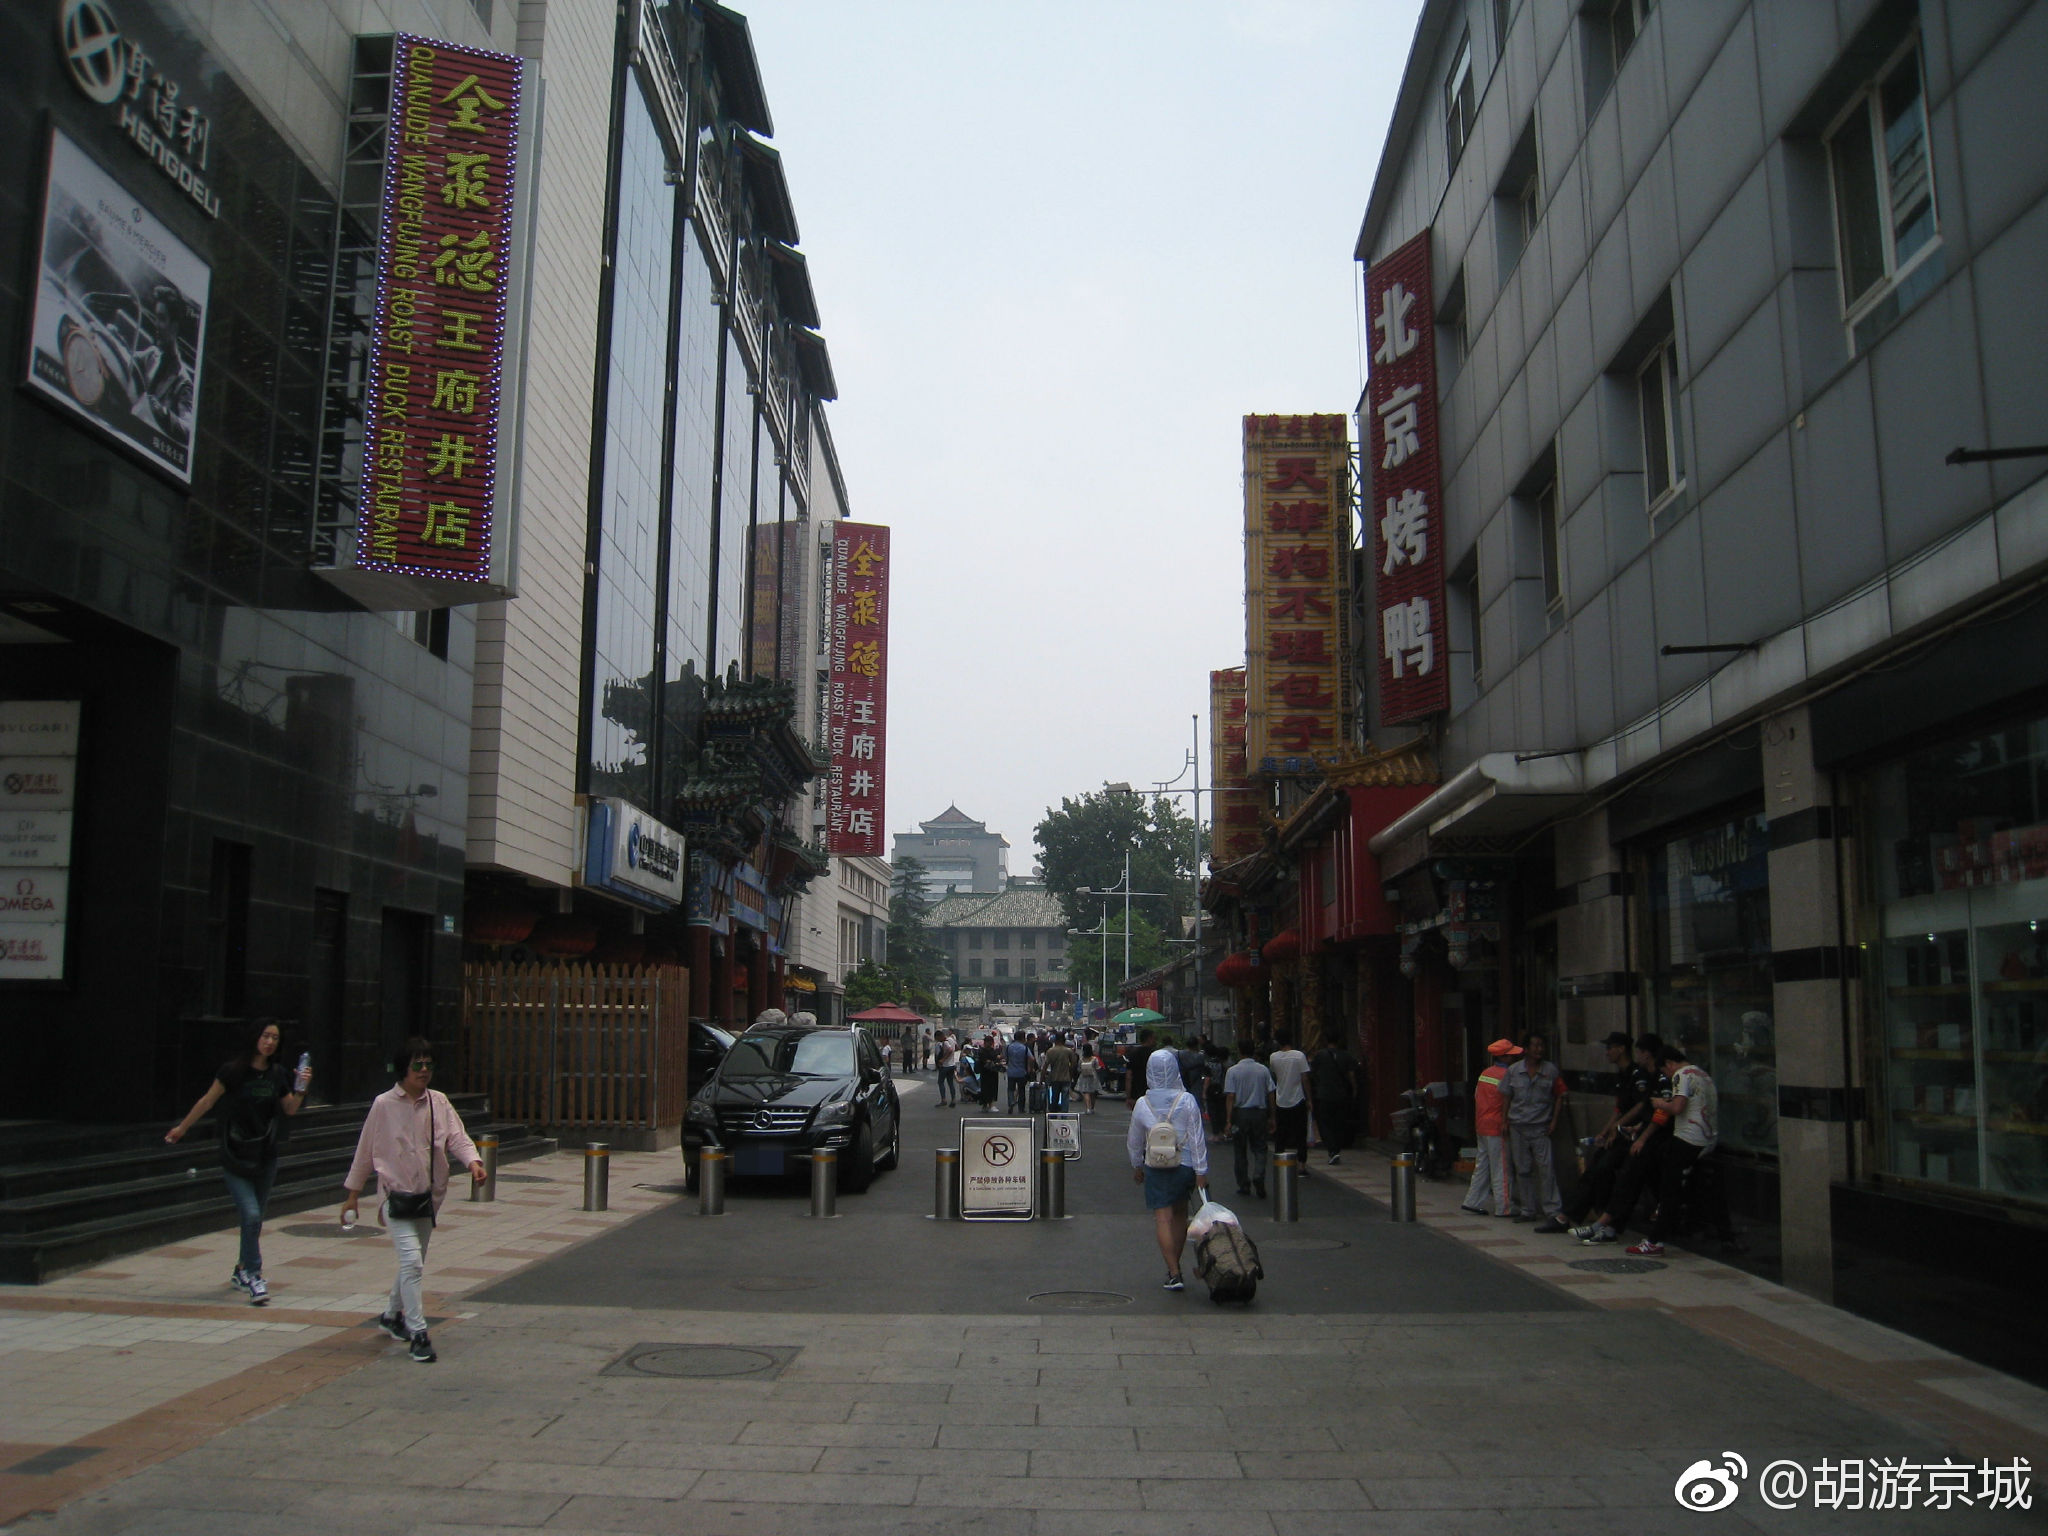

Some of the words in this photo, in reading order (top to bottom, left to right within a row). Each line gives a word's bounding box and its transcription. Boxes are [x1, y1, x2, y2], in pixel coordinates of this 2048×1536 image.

[404, 46, 436, 146] QUANJUDE
[392, 155, 428, 282] WANGFUJING
[387, 286, 416, 356] ROAST
[380, 364, 412, 420] DUCK
[370, 428, 405, 564] RESTAURANT
[1373, 281, 1434, 680] 北京烤鸭
[836, 539, 849, 595] QUANJUDE
[833, 603, 847, 673] WANGFUJING
[1266, 456, 1334, 752] 天津狗不理包子
[832, 681, 845, 718] ROAST
[831, 727, 844, 757] DUCK
[830, 764, 843, 833] RESTAURANT
